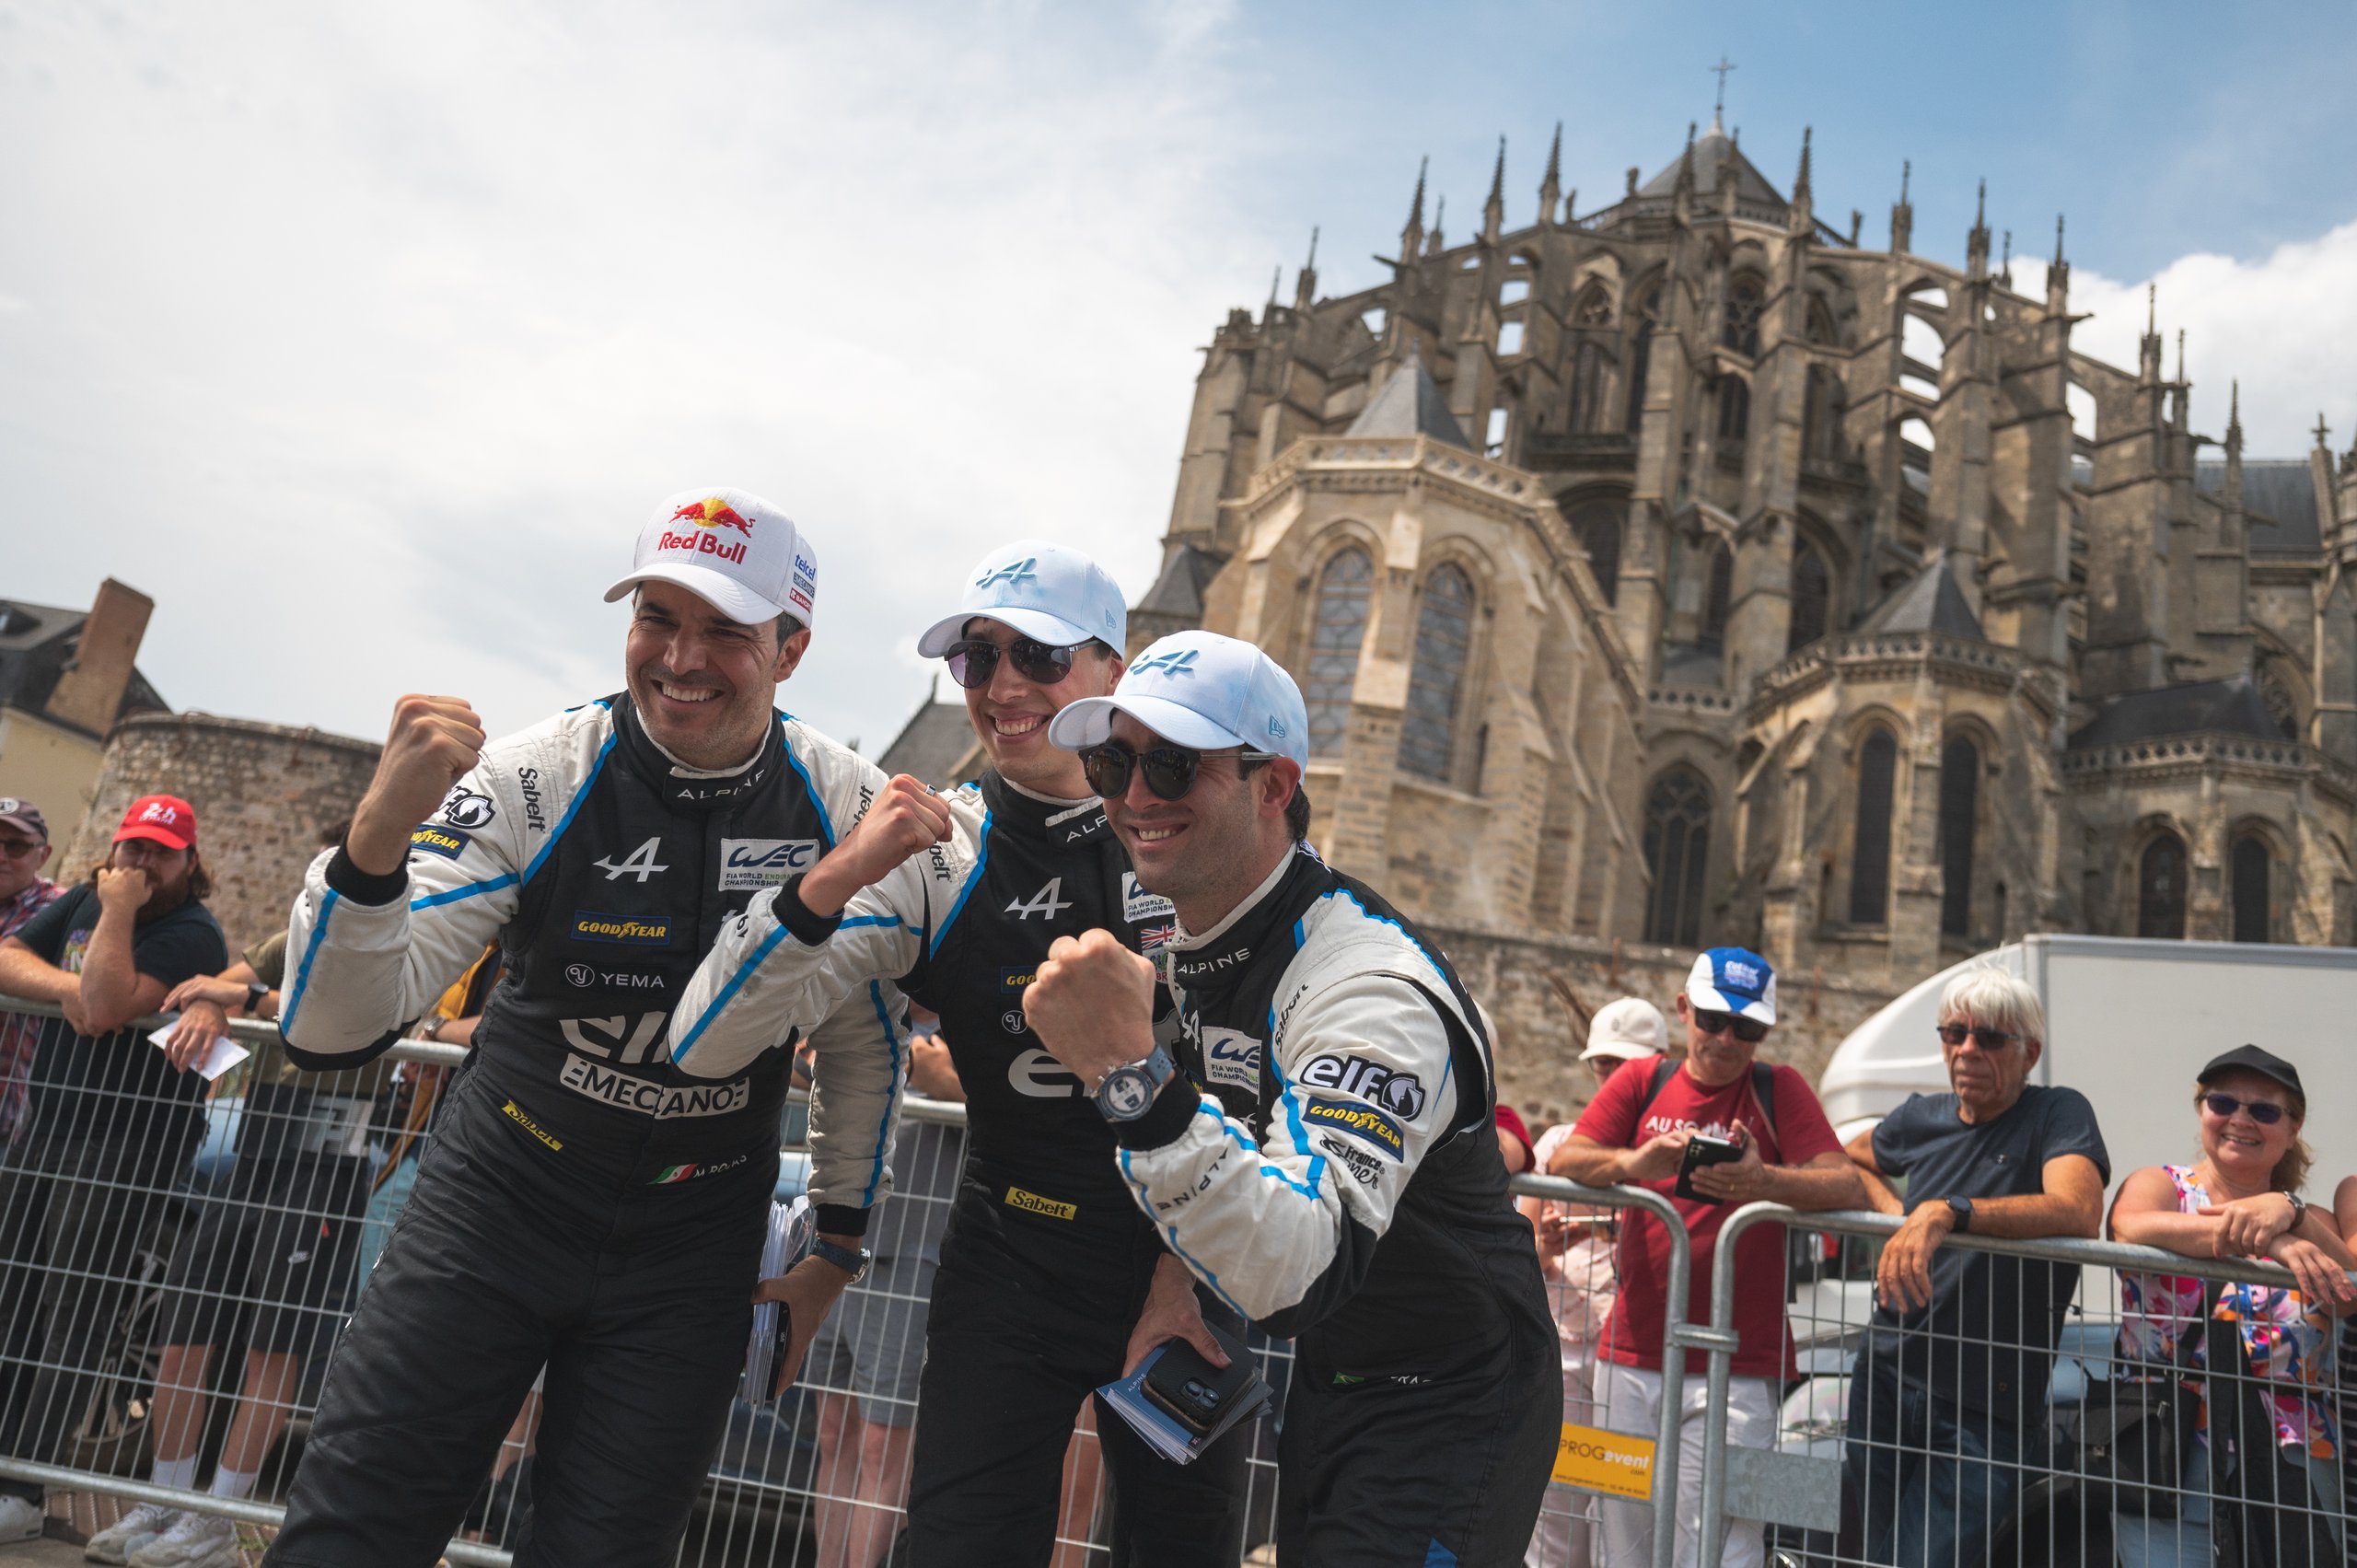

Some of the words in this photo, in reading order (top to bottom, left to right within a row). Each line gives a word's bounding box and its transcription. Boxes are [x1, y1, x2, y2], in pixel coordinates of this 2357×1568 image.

[657, 530, 700, 551] Red
[698, 533, 747, 564] Bull
[795, 553, 817, 581] telcel
[518, 767, 546, 831] Sabelt
[845, 784, 875, 838] belt
[1066, 815, 1107, 842] ALP
[727, 844, 814, 868] WEC
[929, 841, 952, 881] belt
[1128, 904, 1173, 918] CHAMPIONSH
[1138, 899, 1165, 908] WORLD
[577, 921, 667, 939] GOODYEAR
[1178, 947, 1251, 974] ALPINE
[600, 972, 665, 988] YEMA
[559, 1011, 670, 1063] el
[1303, 1058, 1388, 1098] elf
[1309, 1105, 1401, 1149] GOODYEAR
[1013, 1191, 1071, 1217] Sabelt
[1128, 1373, 1146, 1392] ALPINE
[1560, 1438, 1650, 1469] PROGevent
